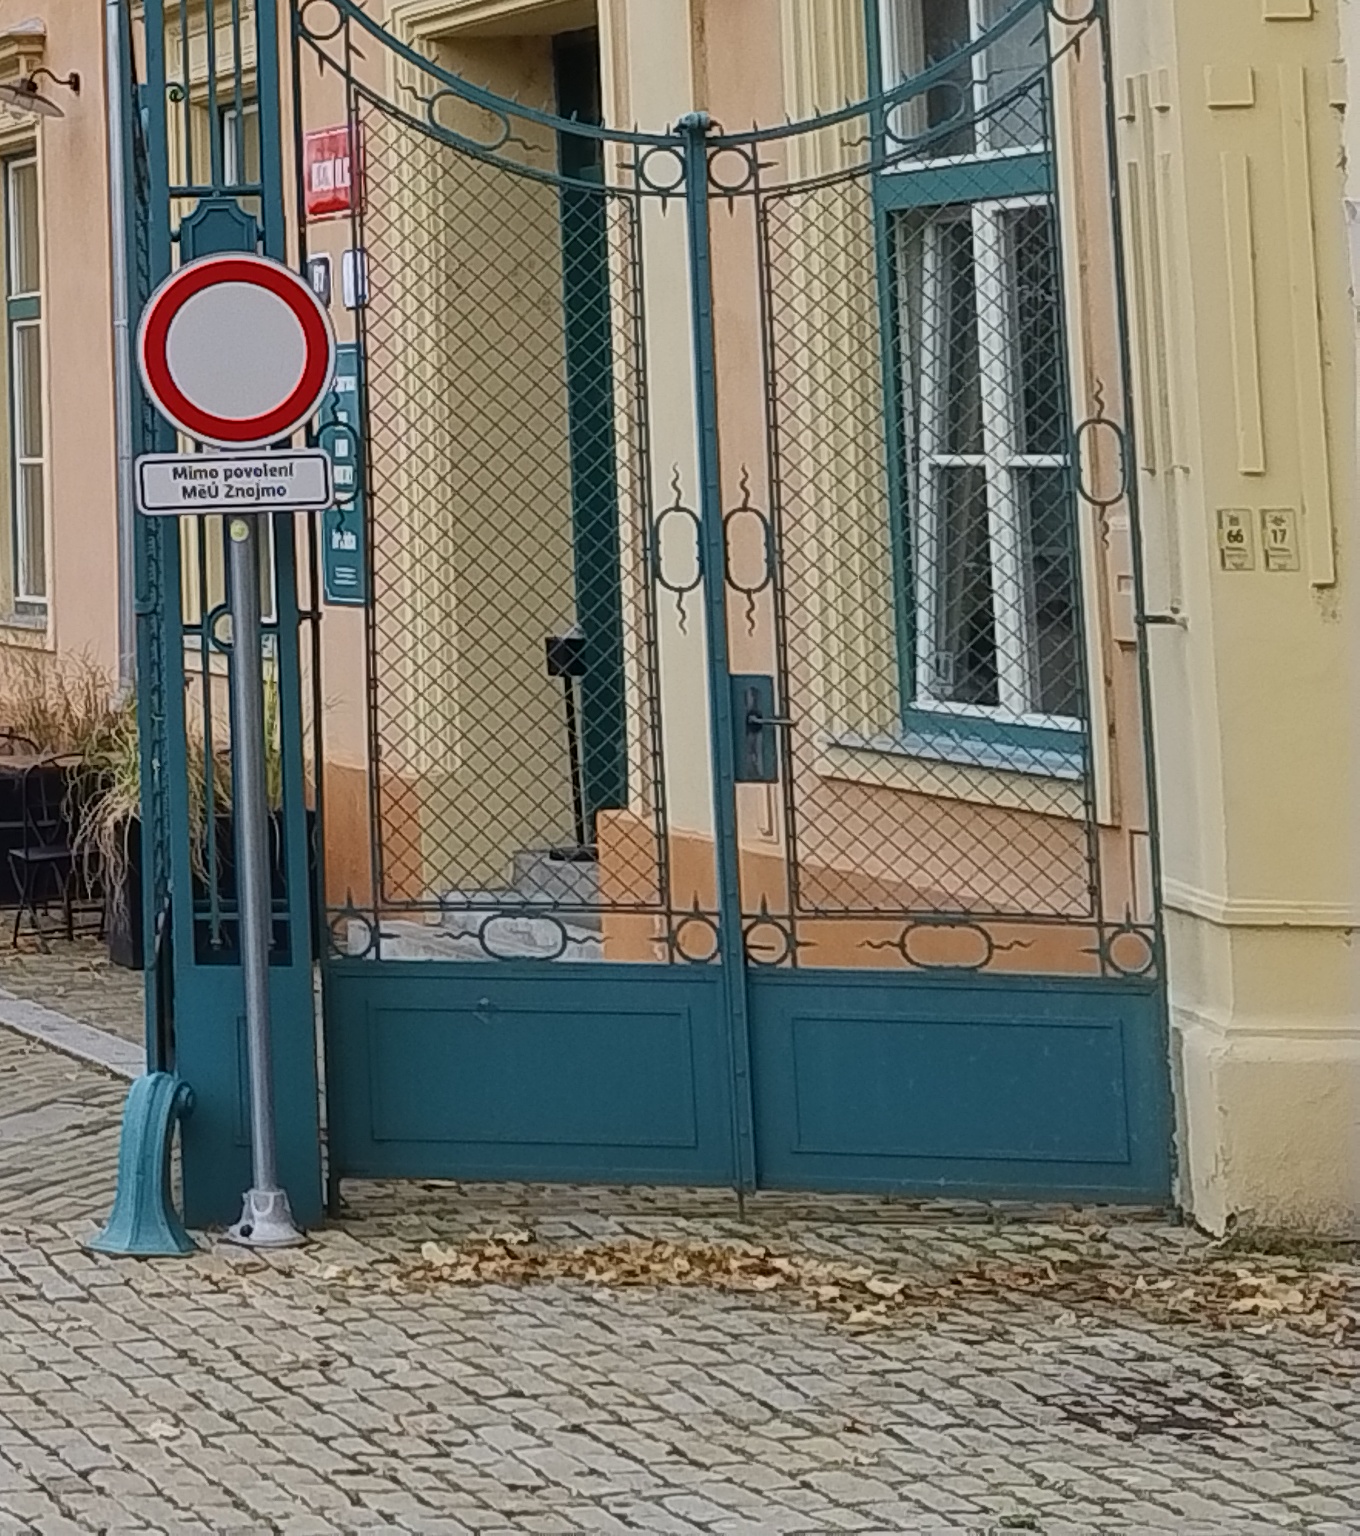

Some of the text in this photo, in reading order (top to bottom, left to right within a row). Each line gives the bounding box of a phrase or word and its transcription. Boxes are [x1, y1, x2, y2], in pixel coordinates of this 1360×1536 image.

[172, 466, 219, 480] Mimo
[224, 481, 287, 501] Znojmo
[1226, 528, 1244, 544] 66
[1270, 528, 1287, 544] 17
